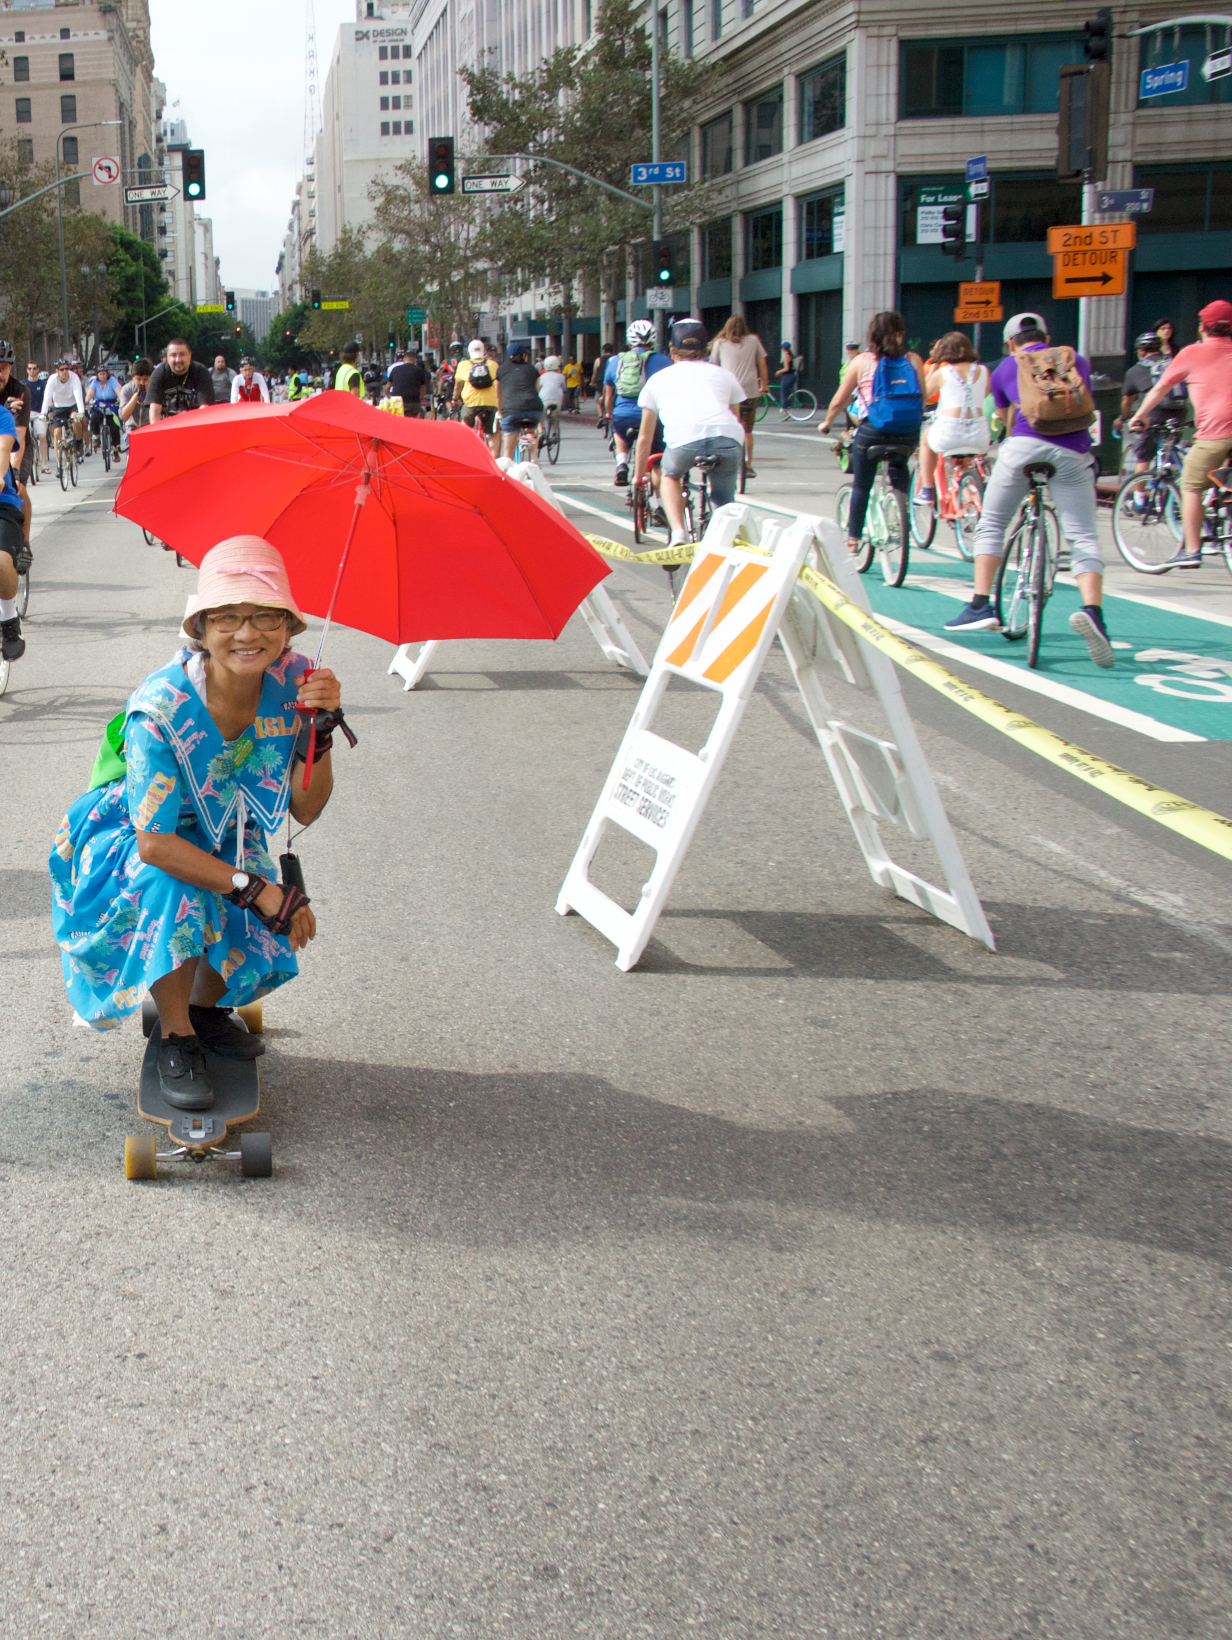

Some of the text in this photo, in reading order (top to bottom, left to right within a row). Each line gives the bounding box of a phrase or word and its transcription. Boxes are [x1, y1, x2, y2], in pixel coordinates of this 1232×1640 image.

[372, 28, 407, 38] DESIGN
[1145, 70, 1184, 90] Spring
[637, 167, 681, 181] 3rd St
[465, 179, 509, 190] ONE WAY
[129, 188, 167, 199] ONE WAY
[920, 194, 936, 203] For
[1062, 229, 1120, 247] 2nd ST
[1062, 250, 1118, 267] DETOUR
[963, 287, 996, 296] DETOUR
[962, 309, 995, 319] 2nd ST
[613, 782, 670, 829] STREET SERVICES
